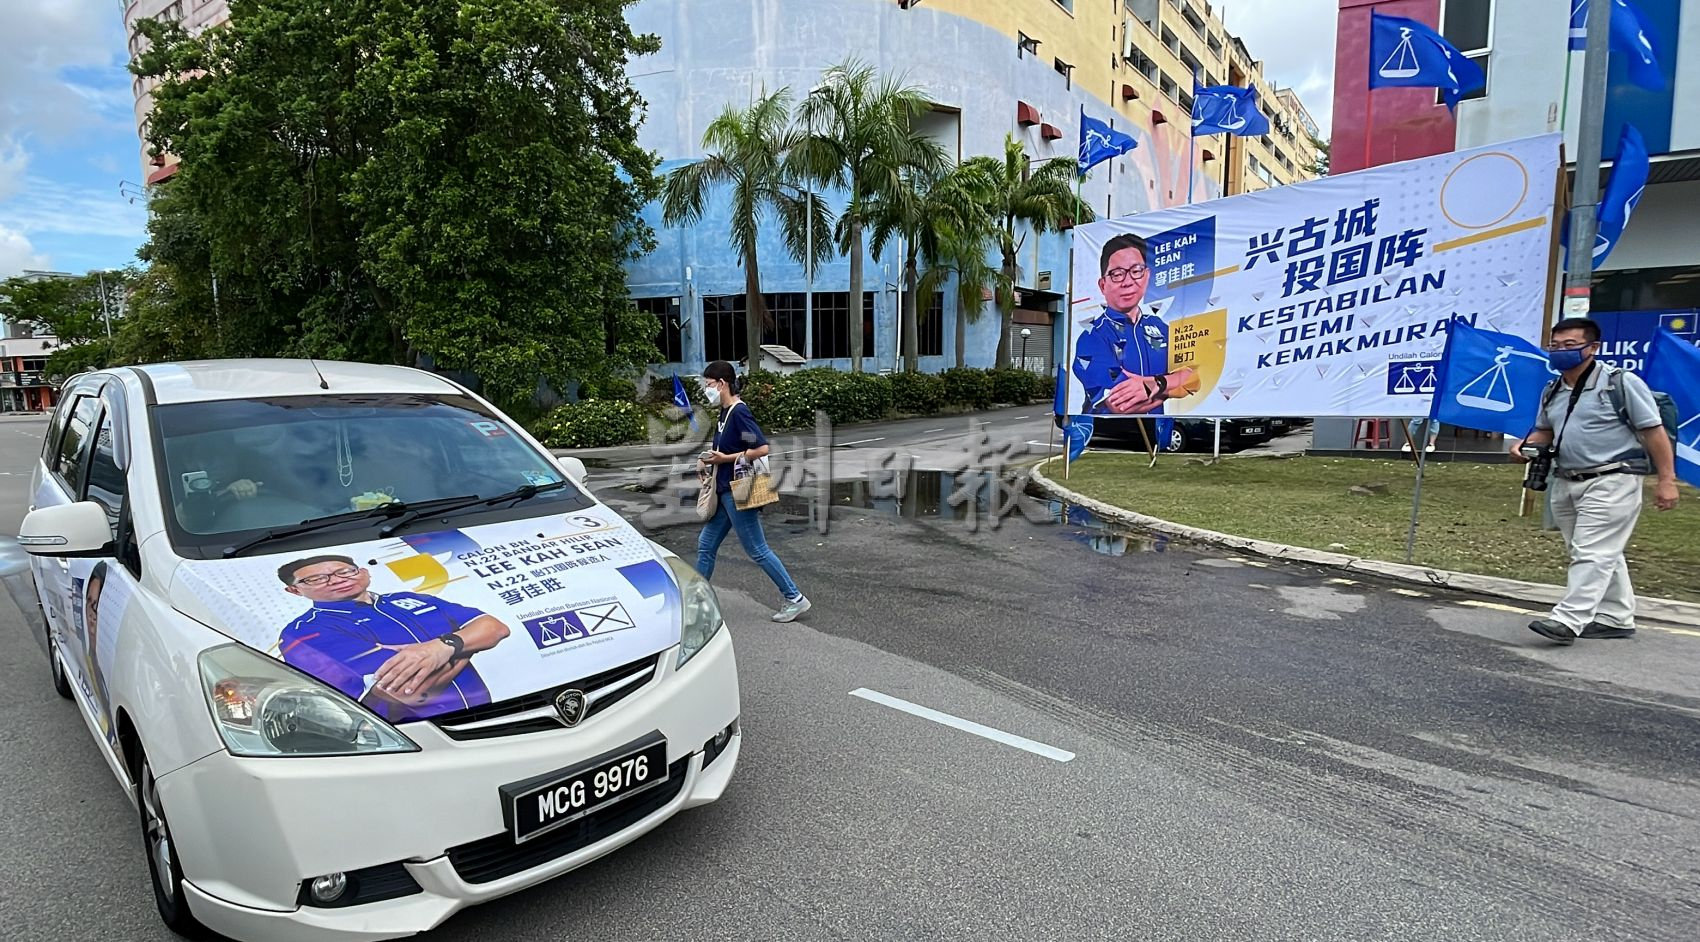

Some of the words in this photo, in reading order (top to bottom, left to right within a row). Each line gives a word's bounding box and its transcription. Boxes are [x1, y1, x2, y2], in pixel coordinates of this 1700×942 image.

[1154, 241, 1172, 255] LEE
[1174, 233, 1197, 249] KAH
[1244, 198, 1380, 271] 兴古城
[1154, 251, 1181, 267] SEAN
[1281, 228, 1428, 298] 投国阵
[1154, 262, 1195, 287] 李佳胜
[1237, 269, 1446, 333] KESTABILAN
[1174, 324, 1194, 335] N.22
[1174, 329, 1210, 342] BANDAR
[1278, 314, 1354, 345] DEMI
[1174, 341, 1196, 351] HILIR
[1388, 352, 1417, 360] Undilah
[573, 516, 601, 527] 3
[457, 544, 507, 561] CALON
[509, 539, 531, 549] BN
[464, 555, 500, 568] N.22
[502, 541, 557, 558] BANDAR
[560, 534, 593, 545] HILIR
[473, 560, 516, 579] LEE
[518, 549, 569, 566] KAH
[570, 537, 623, 554] SEAN
[487, 573, 529, 590] N.22
[498, 577, 566, 606] 李佳胜
[516, 610, 544, 620] Undilah
[544, 605, 566, 614] Calon
[565, 600, 591, 610] Barisan
[538, 780, 586, 823] MCG
[594, 755, 648, 798] 9976
